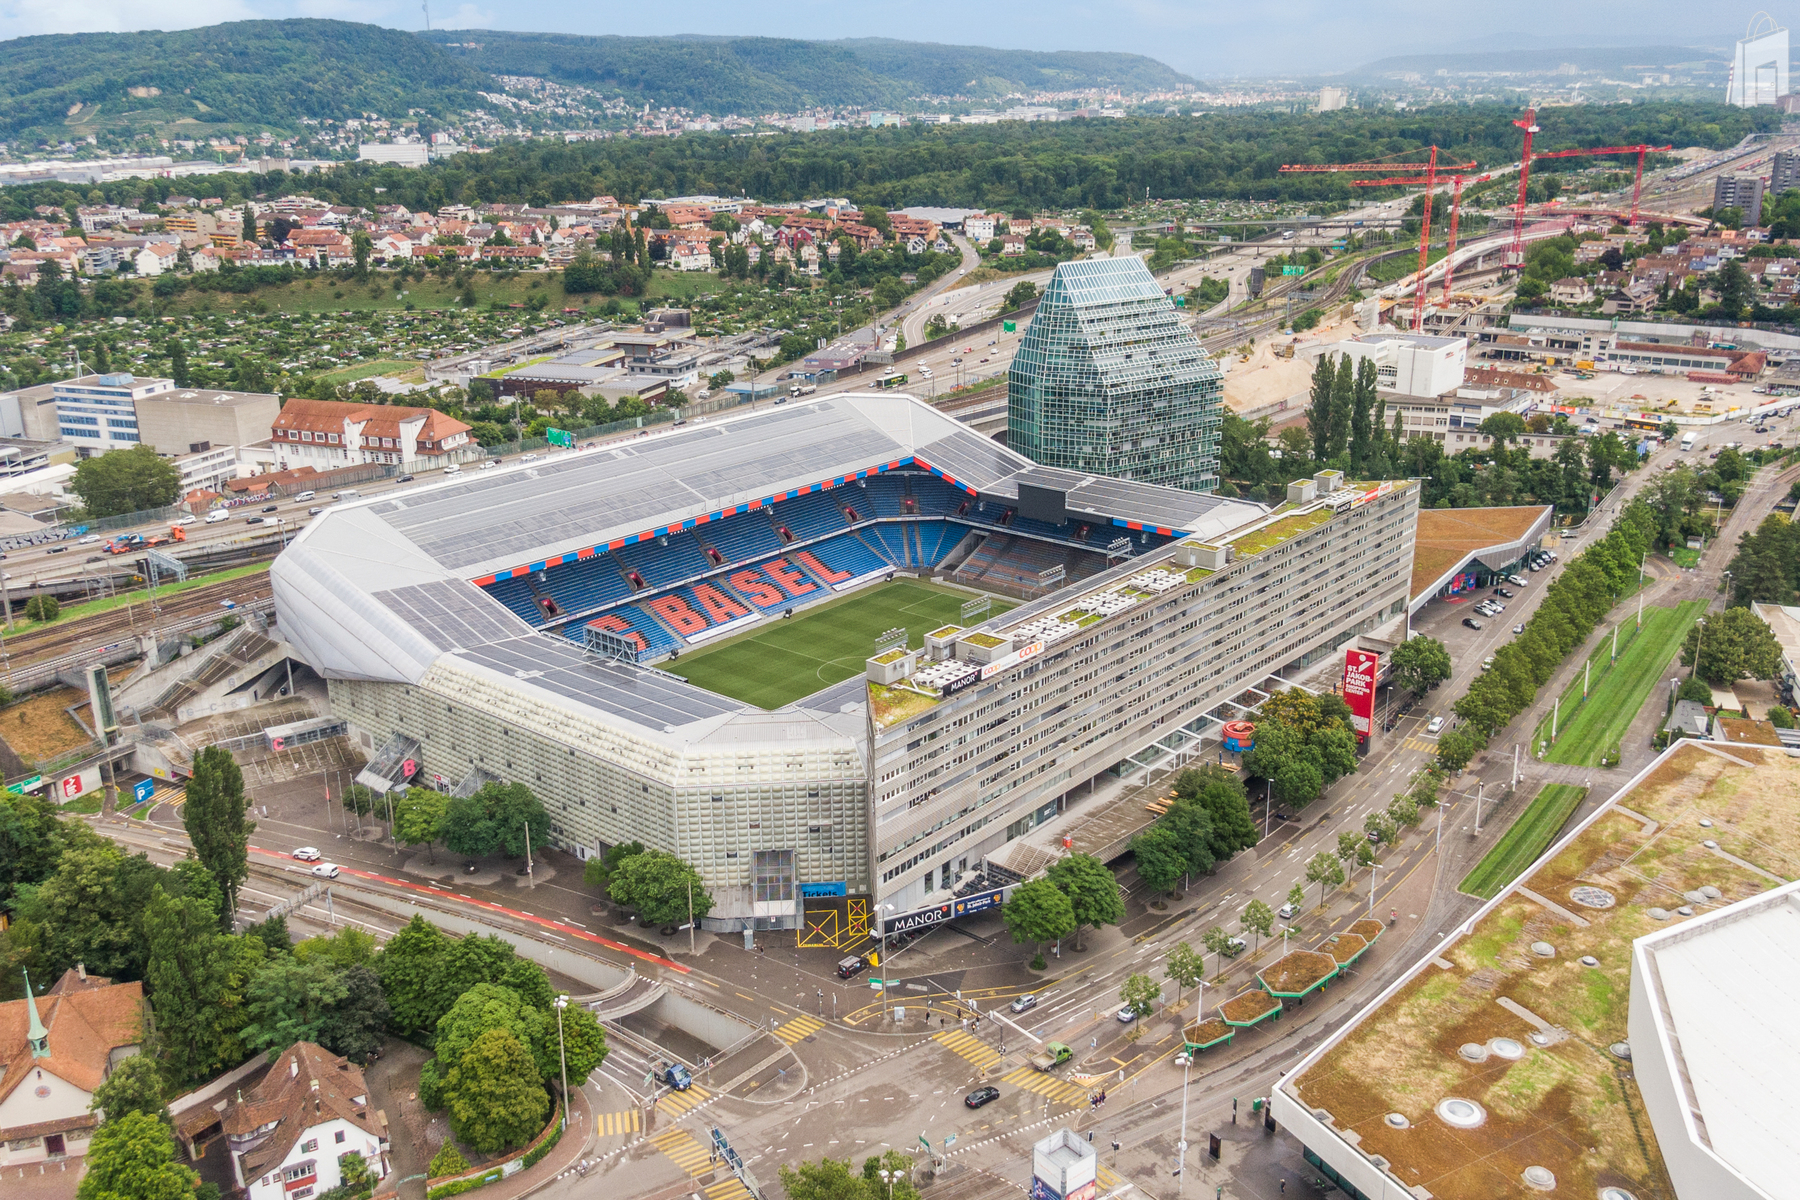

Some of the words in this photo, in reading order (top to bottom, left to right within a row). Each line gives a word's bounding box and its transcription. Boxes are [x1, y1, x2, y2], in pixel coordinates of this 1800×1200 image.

[649, 550, 854, 636] BASEL
[1019, 641, 1043, 659] coop
[984, 663, 1001, 676] coop
[1347, 664, 1358, 673] ST.
[951, 673, 976, 692] MANOR
[1346, 677, 1366, 688] PARK
[273, 737, 284, 750] C
[403, 758, 416, 777] B
[137, 789, 146, 801] P
[802, 890, 839, 898] Tickets
[894, 910, 942, 931] MANOR
